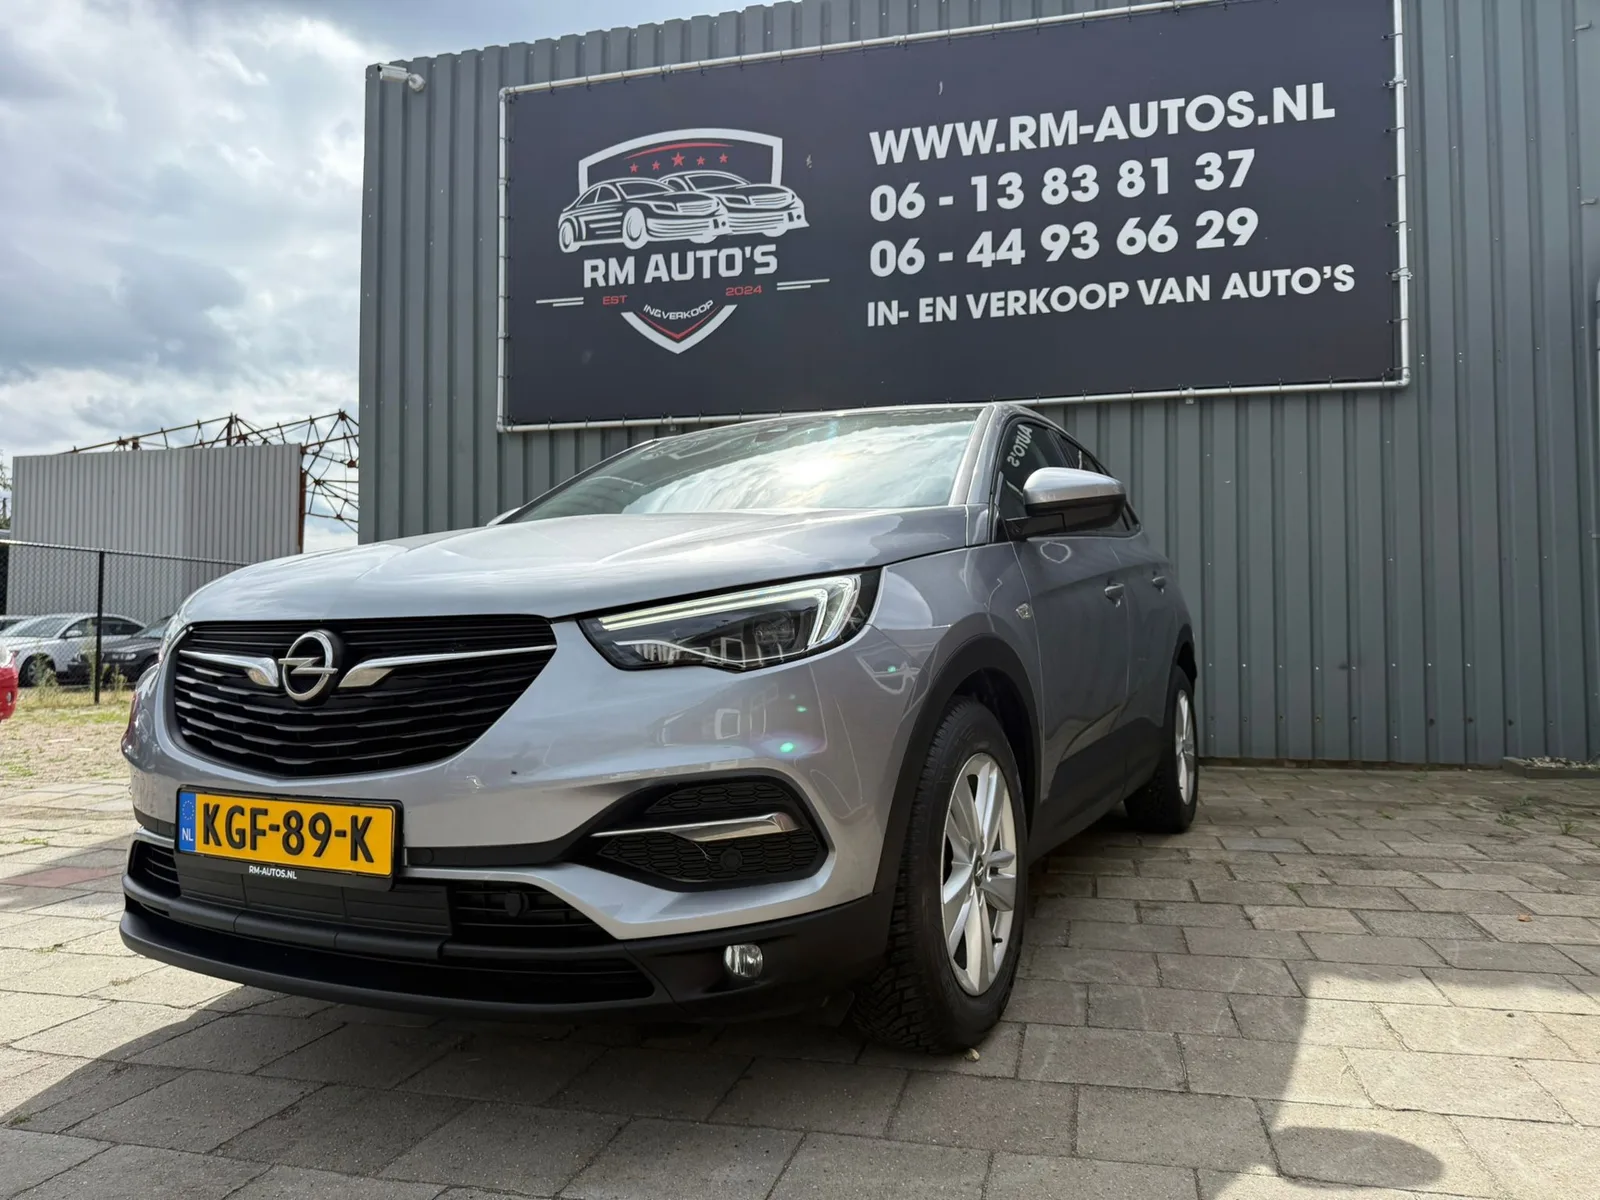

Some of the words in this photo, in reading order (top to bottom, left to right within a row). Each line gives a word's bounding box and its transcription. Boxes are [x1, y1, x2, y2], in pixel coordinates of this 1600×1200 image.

[869, 82, 1336, 166] WWW.RM-AUTOS.NL
[870, 181, 926, 222] 06
[938, 195, 954, 206] -
[970, 171, 1025, 212] 13
[1041, 164, 1100, 206] 83
[1116, 156, 1169, 198] 81
[1194, 148, 1256, 191] 37
[583, 255, 635, 288] RM
[644, 243, 778, 284] AUTO'S
[870, 237, 926, 277] 06
[938, 251, 954, 262] -
[966, 227, 1026, 268] 44
[1040, 221, 1100, 262] 93
[1116, 213, 1179, 256] 66
[1195, 206, 1259, 250] 29
[602, 295, 628, 306] EST
[725, 285, 763, 297] 2024
[867, 300, 909, 327] IN-
[919, 295, 957, 323] EN
[965, 281, 1130, 319] VERKOOP
[1136, 274, 1210, 306] VAN
[1220, 263, 1355, 300] AUTO'S
[182, 827, 194, 842] NL
[203, 803, 374, 864] KGF-89-K
[248, 865, 297, 880] RM-AUTOS.NL
